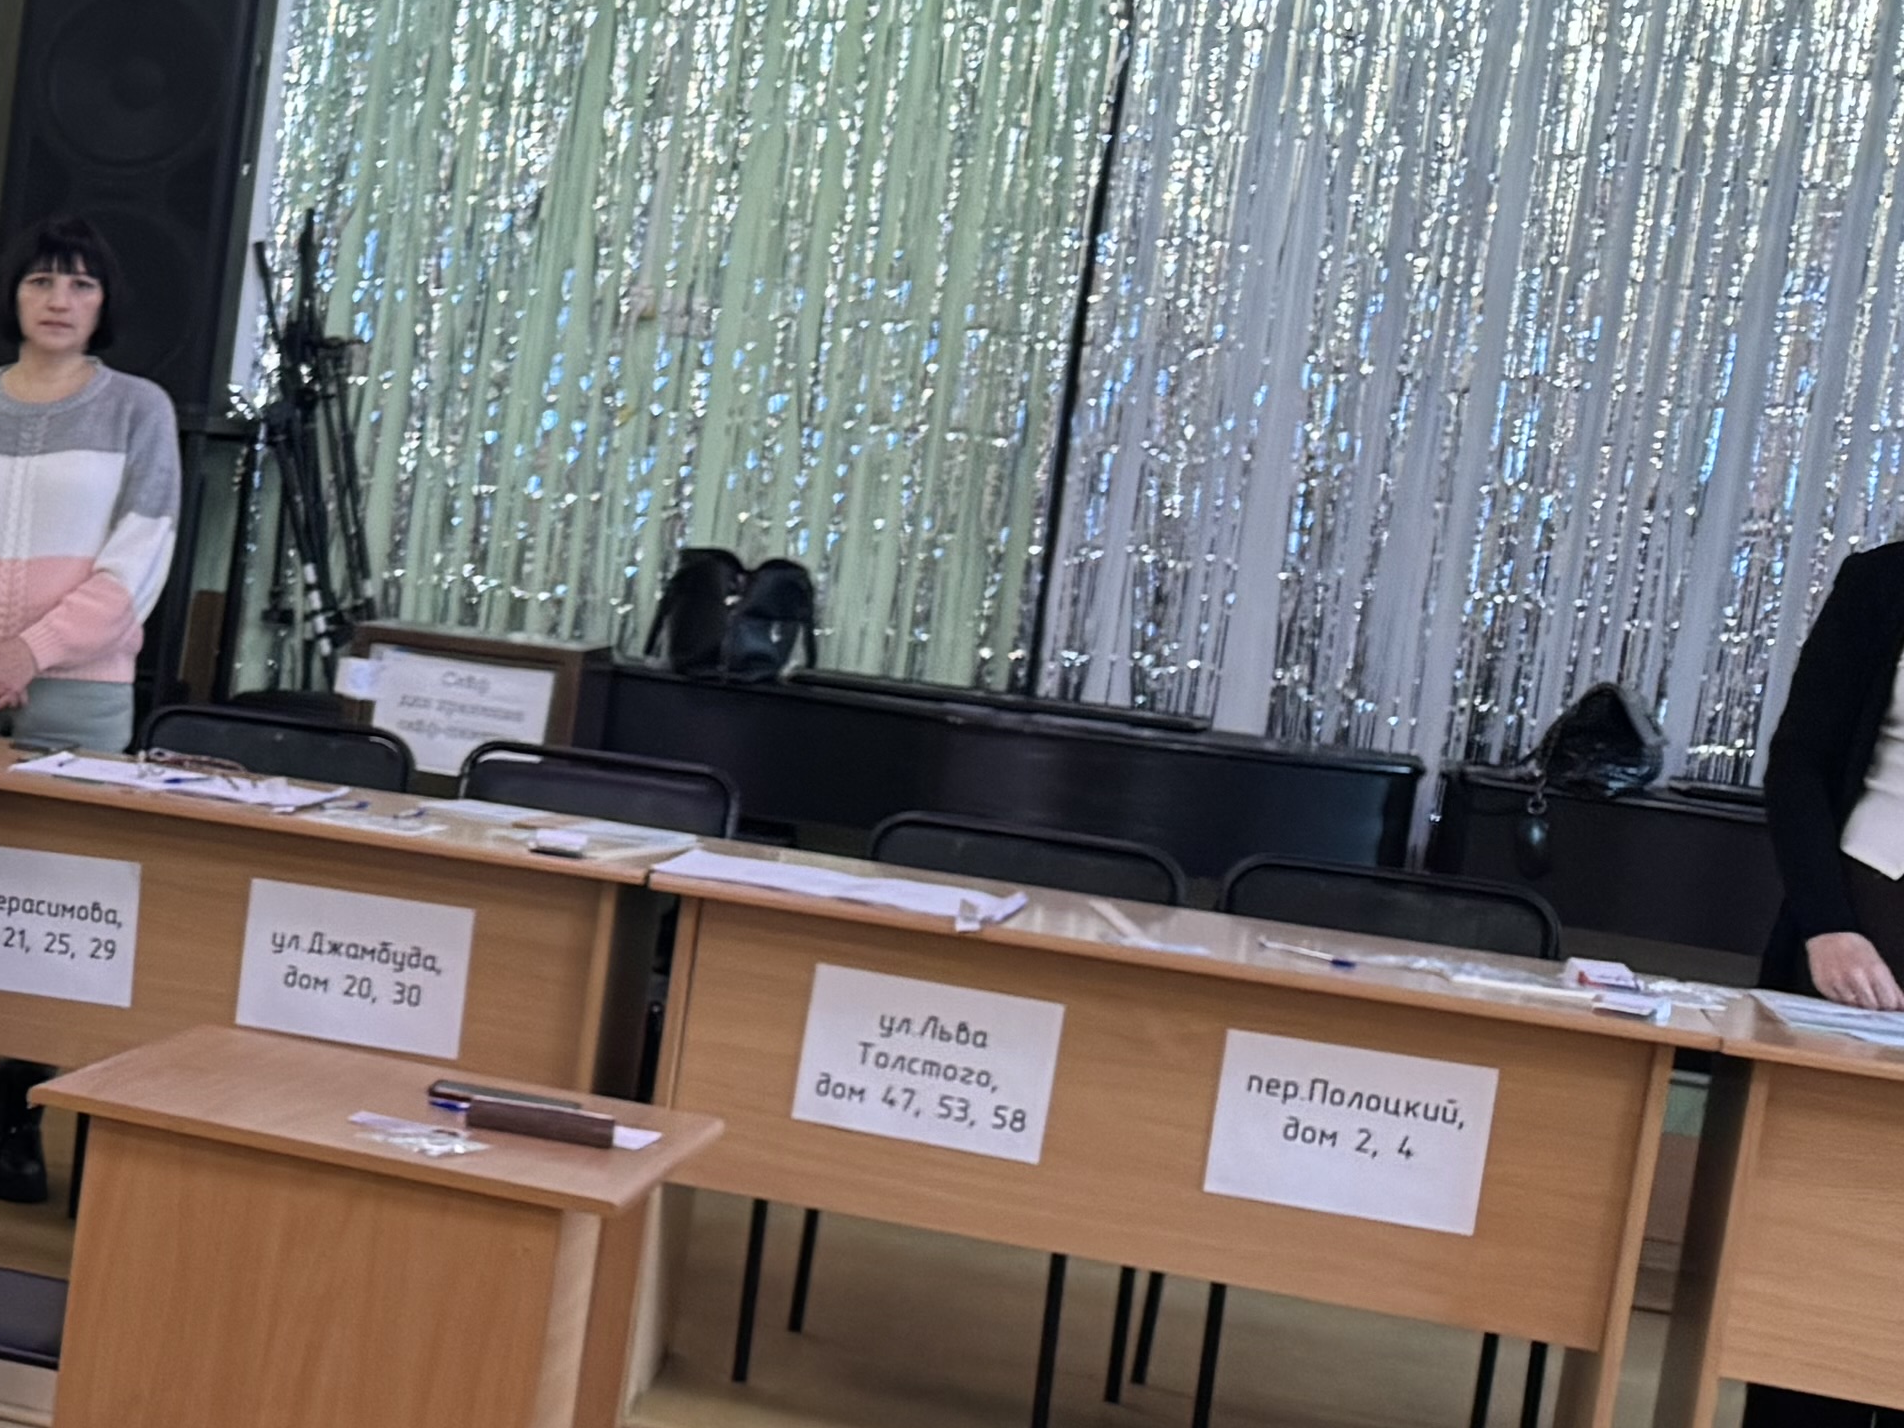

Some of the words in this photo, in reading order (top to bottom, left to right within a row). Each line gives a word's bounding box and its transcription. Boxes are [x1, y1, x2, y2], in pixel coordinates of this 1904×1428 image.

[3, 927, 31, 955] 21,
[44, 931, 75, 960] 25,
[90, 937, 117, 962] 29
[284, 965, 329, 994] дом
[343, 975, 377, 1005] 20,
[392, 982, 421, 1008] 30
[879, 1012, 988, 1049] ул.Льва
[859, 1042, 998, 1093] Толстого,
[815, 1072, 865, 1105] дом
[882, 1086, 920, 1119] 47,
[938, 1096, 975, 1128] 53,
[993, 1103, 1027, 1134] 58
[1247, 1073, 1465, 1130] пер.Полоцкий,
[1282, 1116, 1337, 1149] дом
[1354, 1128, 1378, 1159] 2,
[1396, 1134, 1414, 1160] 4
